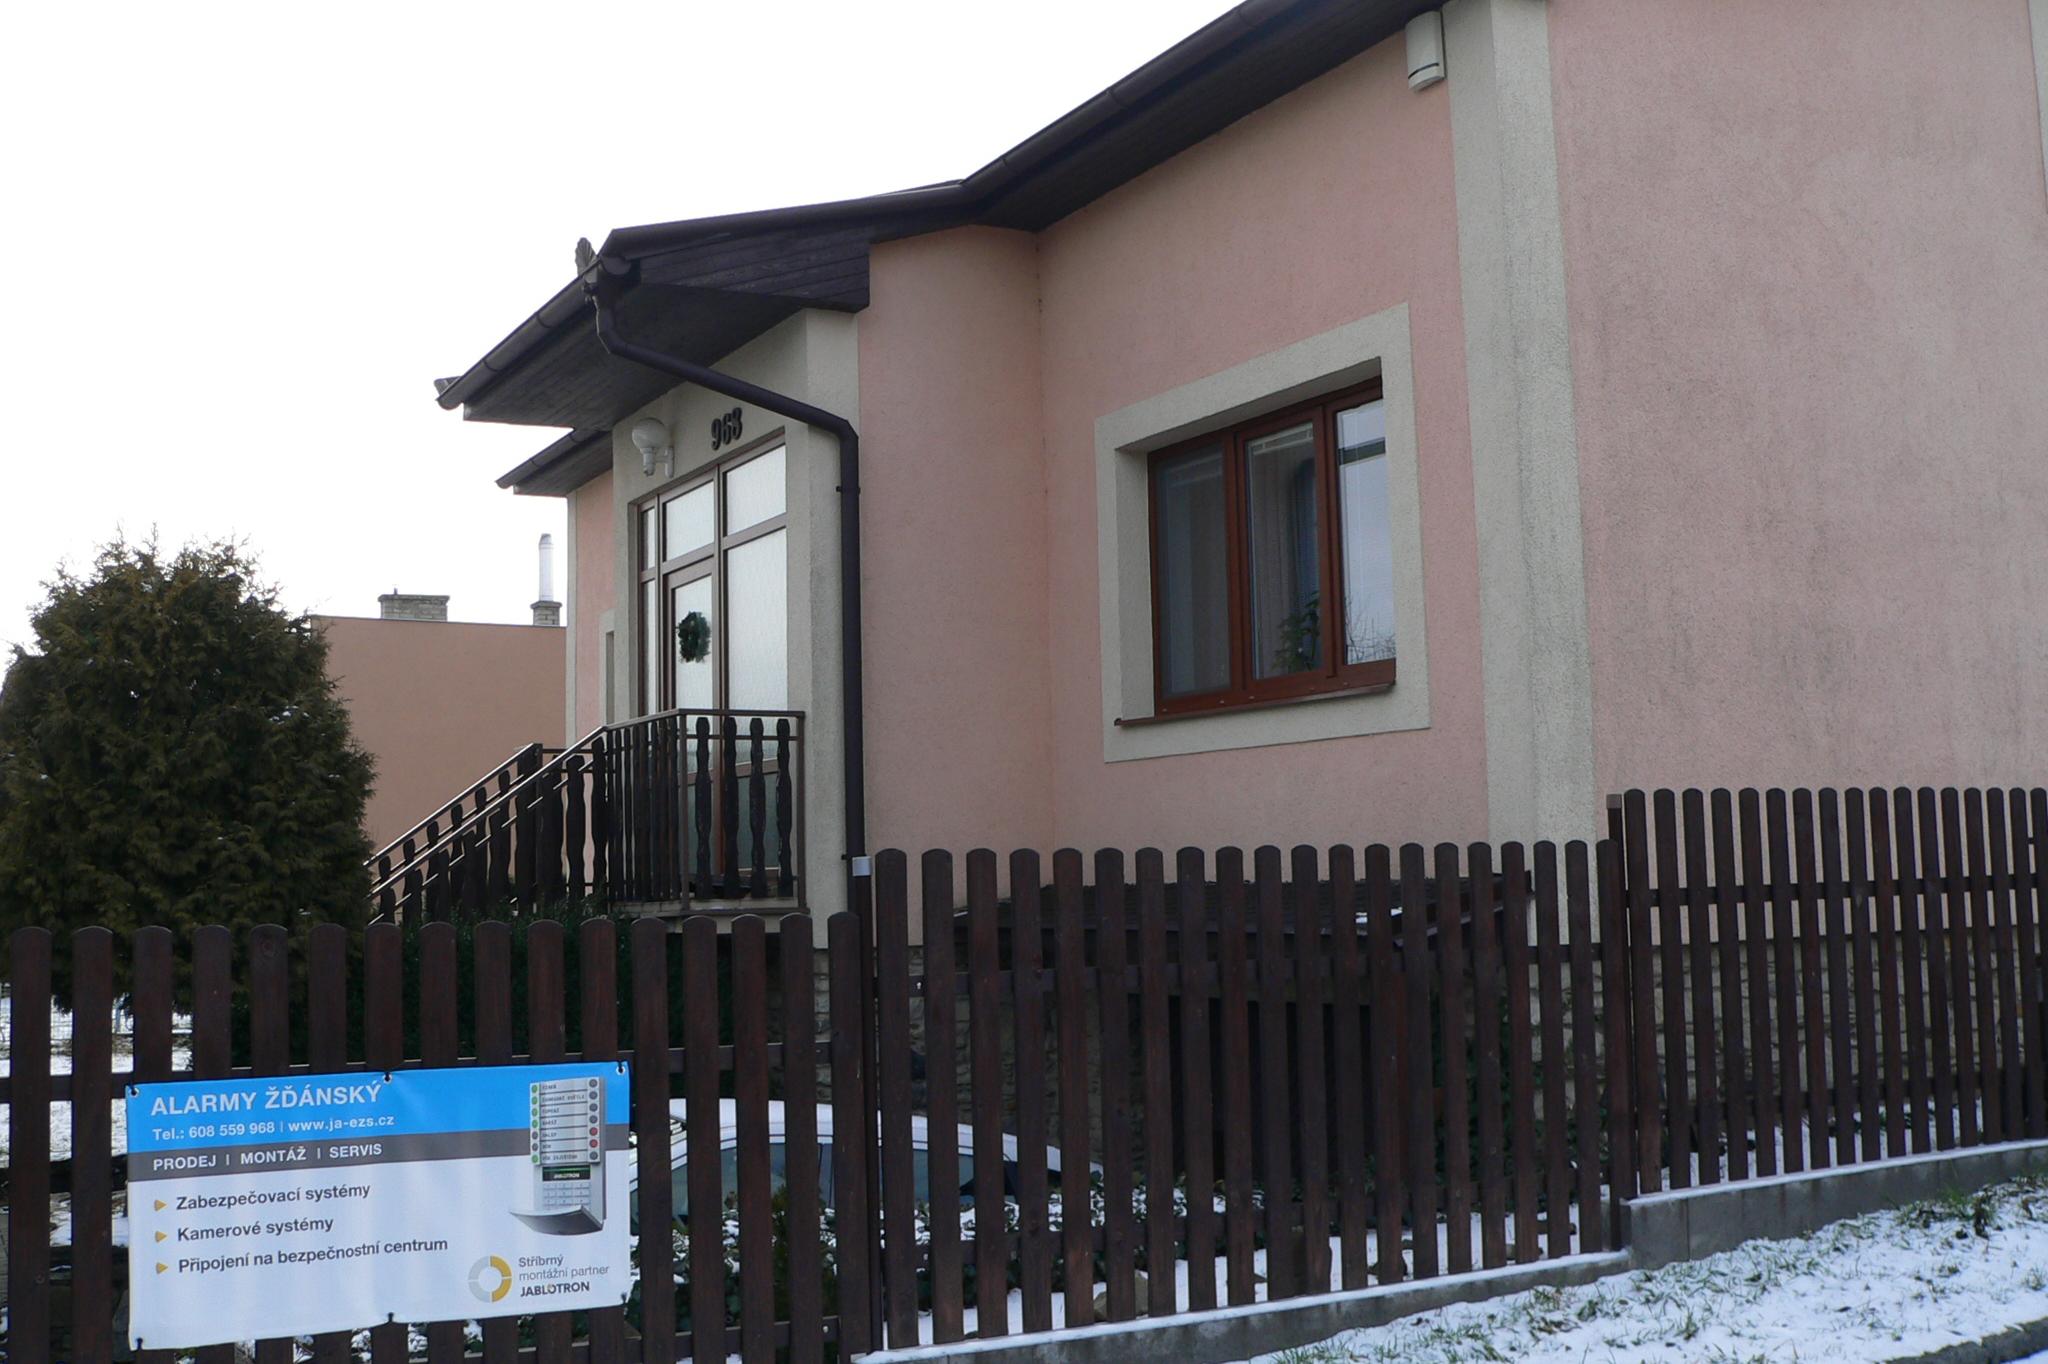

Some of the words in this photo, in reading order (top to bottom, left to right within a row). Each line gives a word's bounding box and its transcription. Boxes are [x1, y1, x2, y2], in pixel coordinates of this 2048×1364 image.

[151, 1091, 257, 1116] ALARMY
[264, 1081, 381, 1109] ŽĎÁNSKÝ
[152, 1128, 184, 1141] Tel.:
[189, 1125, 215, 1138] 608
[219, 1123, 245, 1136] 559
[249, 1121, 274, 1134] 968
[288, 1116, 395, 1132] www.ja-ezs.cz
[153, 1155, 216, 1171] PRODEJ
[241, 1146, 306, 1165] MONTÁŽ
[329, 1144, 382, 1159] SERVIS
[176, 1189, 301, 1211] Zabezpečovací
[305, 1184, 370, 1204] systémy
[177, 1221, 261, 1242] Kamerové
[266, 1218, 333, 1237] systémy
[178, 1253, 249, 1274] Připojení
[253, 1254, 273, 1266] na
[278, 1243, 380, 1266] bezpečnostní
[384, 1239, 448, 1254] centrum
[518, 1254, 564, 1269] Stříbrný
[519, 1268, 568, 1281] montážní
[571, 1265, 610, 1279] partner
[520, 1281, 590, 1298] JABLOTRON
